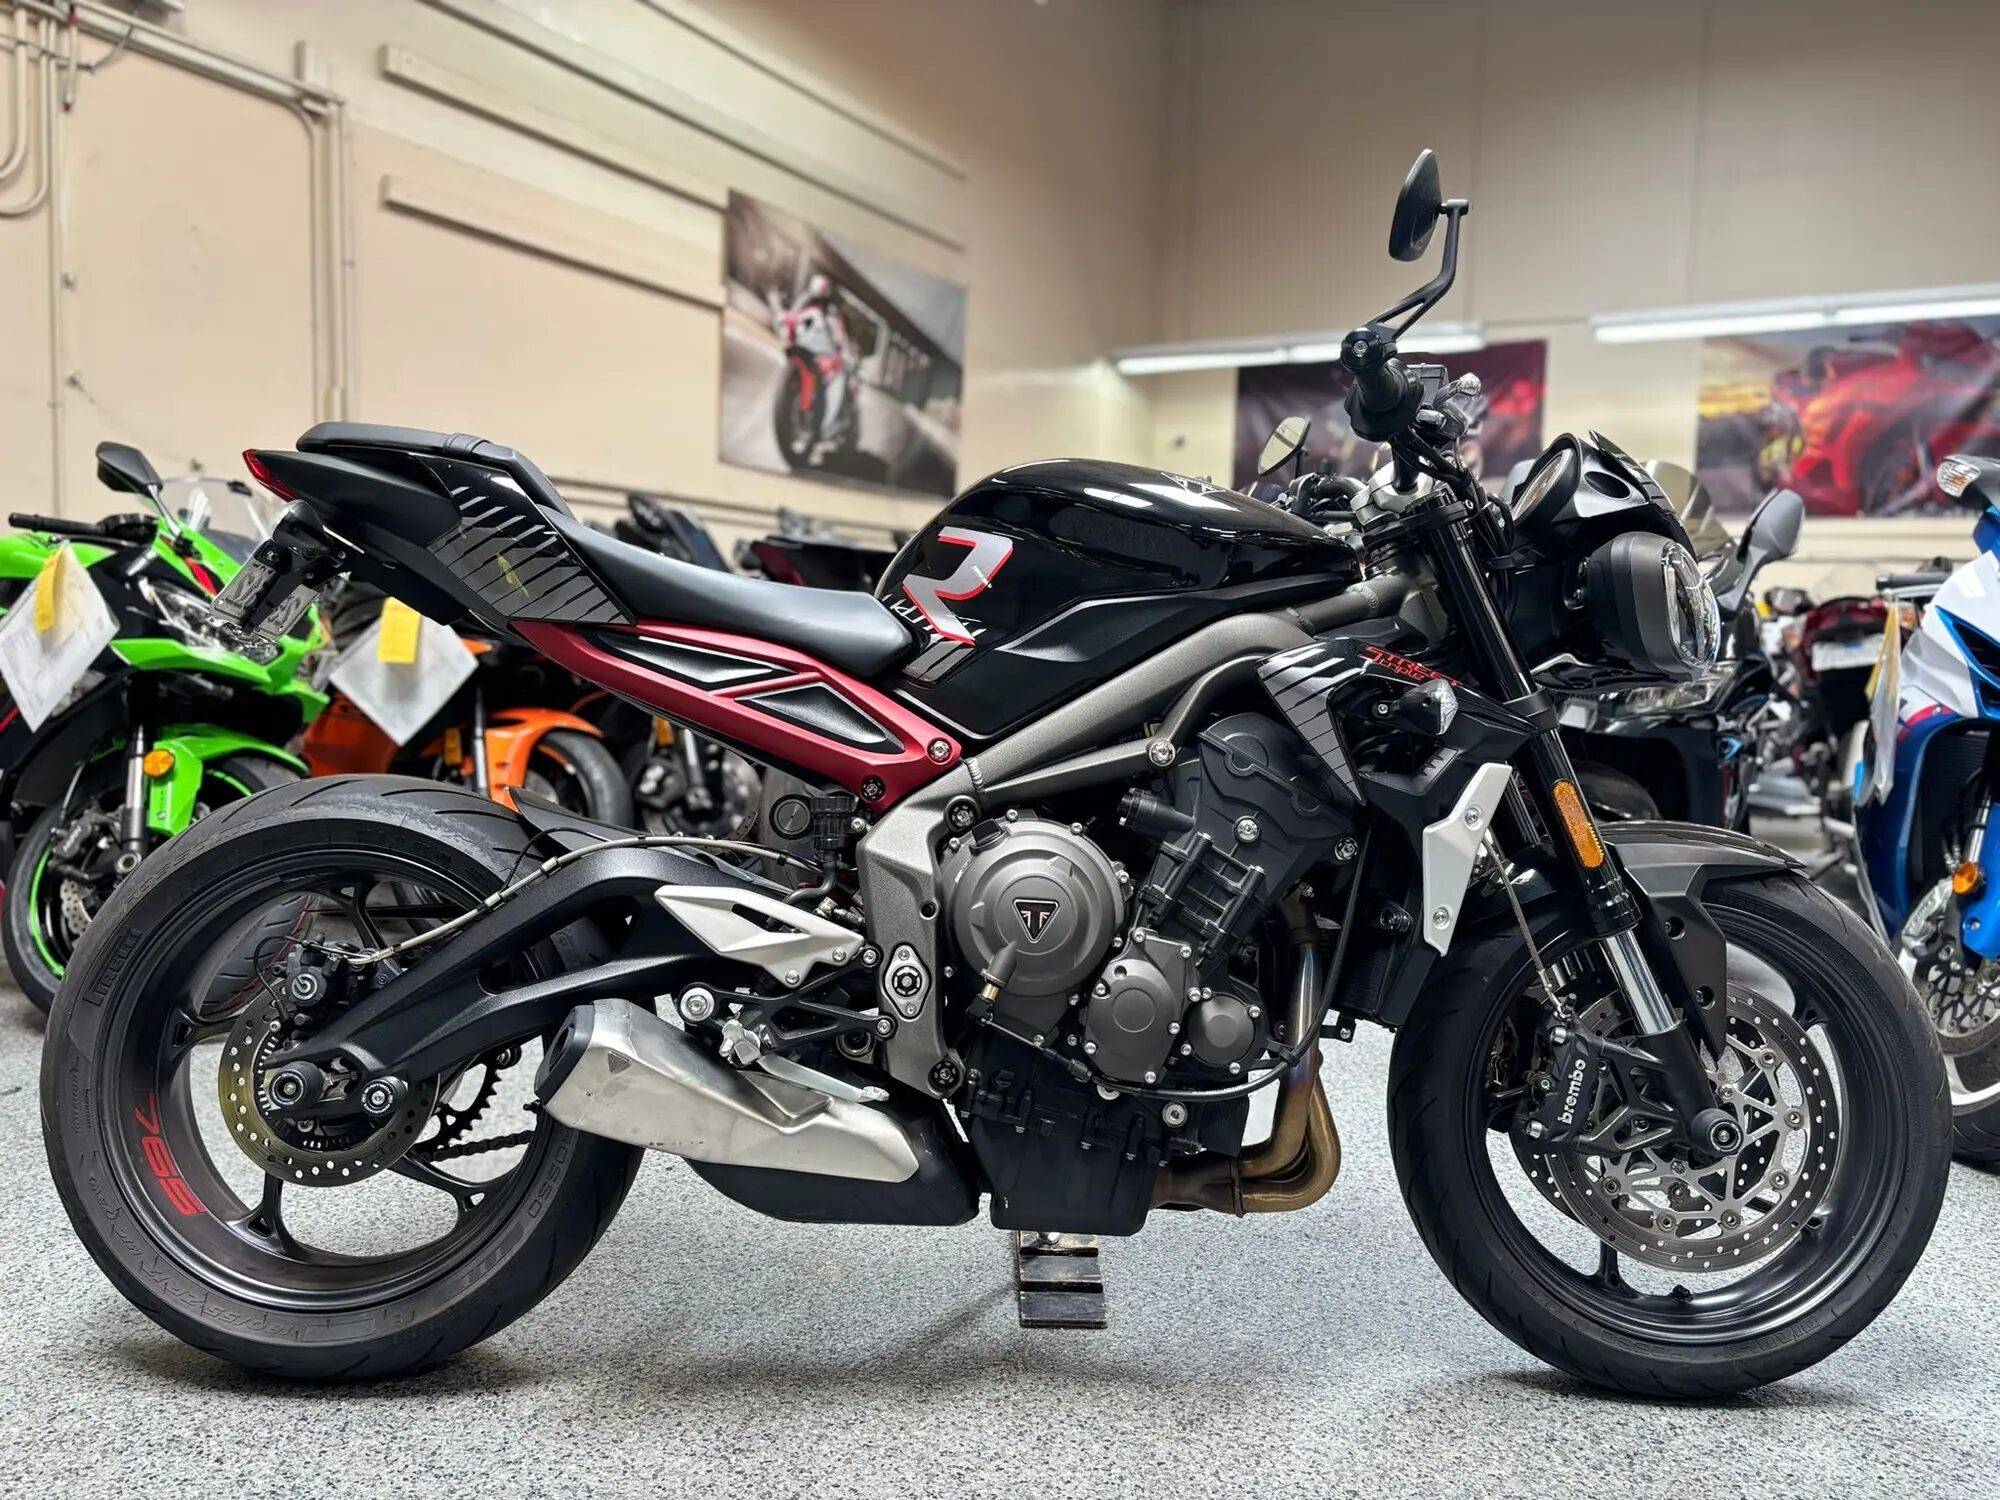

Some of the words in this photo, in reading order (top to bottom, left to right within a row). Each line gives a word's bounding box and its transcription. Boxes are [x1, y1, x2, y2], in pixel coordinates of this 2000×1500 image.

[902, 526, 1013, 646] R
[1557, 1059, 1586, 1124] brembo
[133, 1090, 208, 1216] 765
